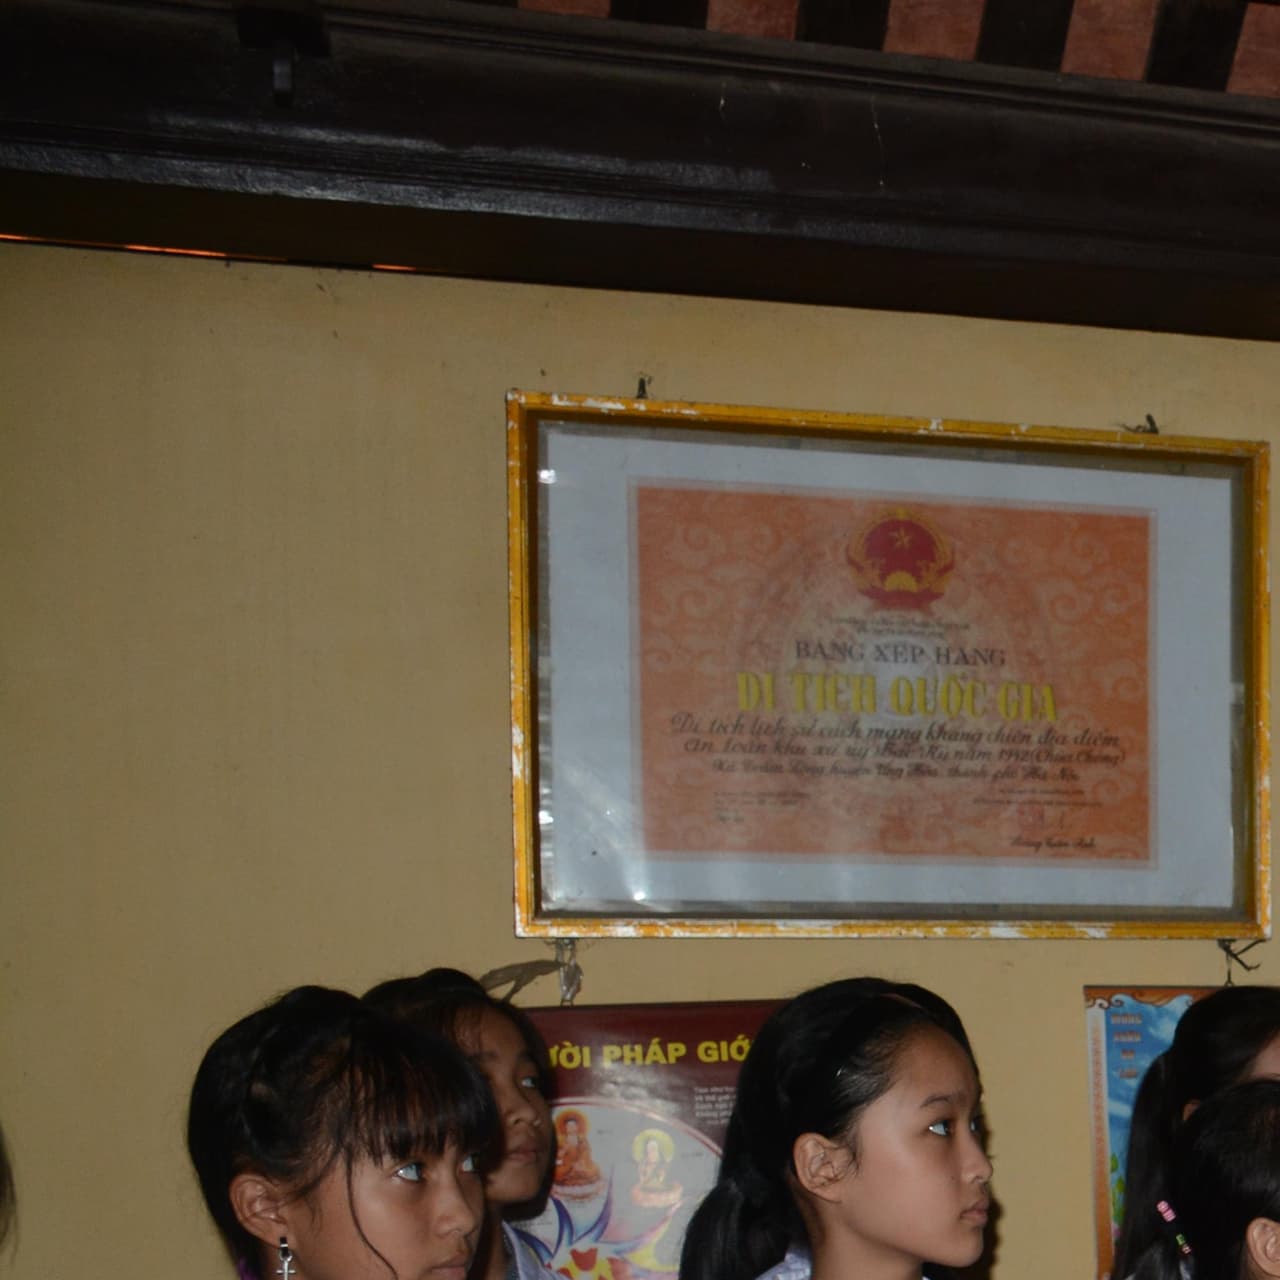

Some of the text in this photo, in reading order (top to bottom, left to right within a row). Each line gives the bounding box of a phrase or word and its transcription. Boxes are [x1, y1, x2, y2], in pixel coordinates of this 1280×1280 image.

[736, 671, 776, 711] DI
[996, 681, 1057, 721] GIA
[603, 1038, 687, 1068] PHÁP
[697, 1034, 752, 1063] GIỚ
